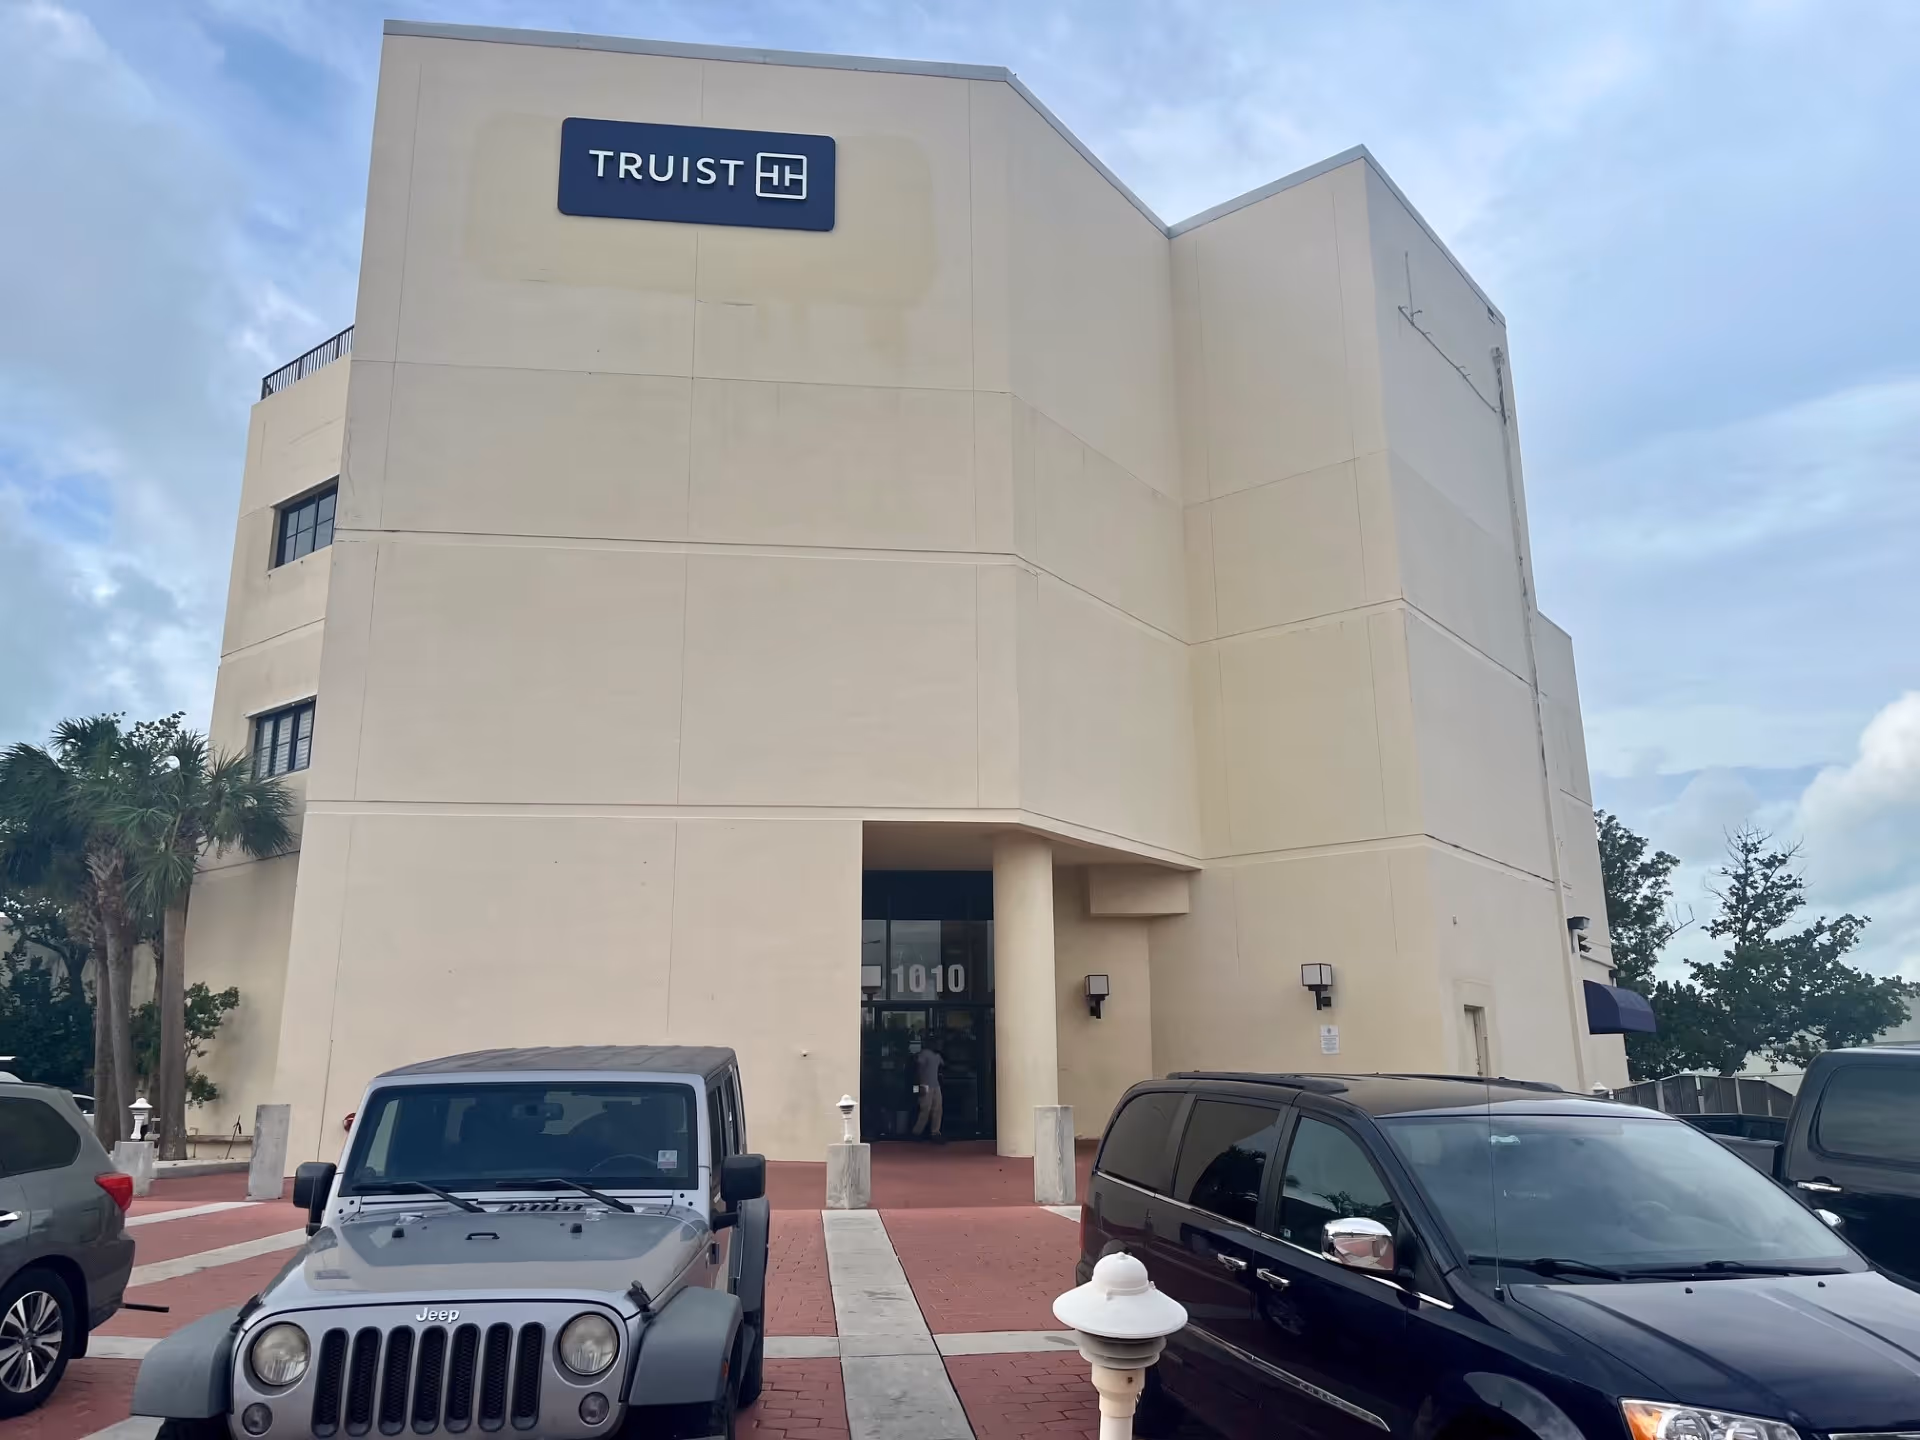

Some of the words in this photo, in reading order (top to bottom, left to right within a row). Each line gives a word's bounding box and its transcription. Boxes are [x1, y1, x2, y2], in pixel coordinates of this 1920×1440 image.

[588, 149, 745, 186] TRUIST
[892, 964, 965, 993] 1010
[415, 1306, 460, 1324] Jeep
